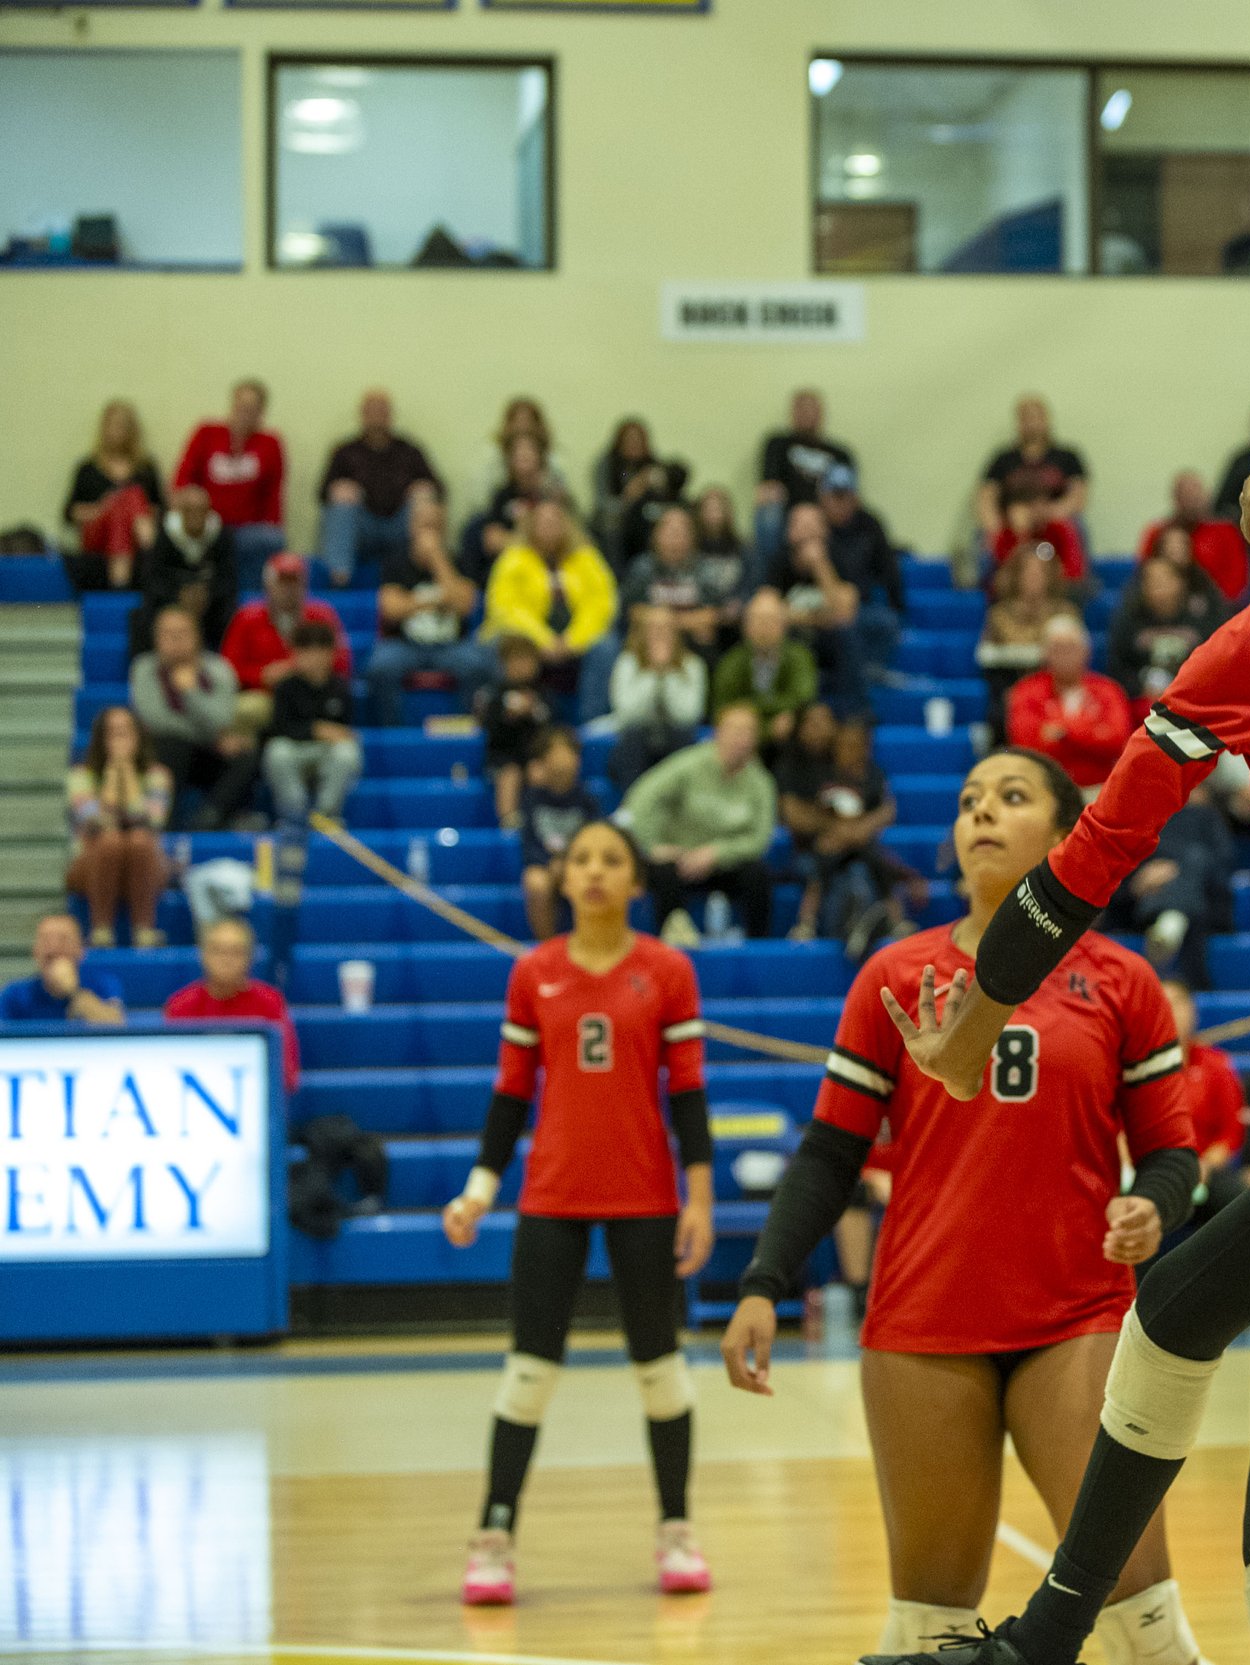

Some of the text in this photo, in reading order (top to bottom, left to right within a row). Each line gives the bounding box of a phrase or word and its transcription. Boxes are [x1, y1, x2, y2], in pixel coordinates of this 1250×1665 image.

[577, 1013, 614, 1073] 2
[991, 1024, 1039, 1103] 8
[0, 1066, 246, 1140] TIAN
[6, 1162, 222, 1234] EMY
